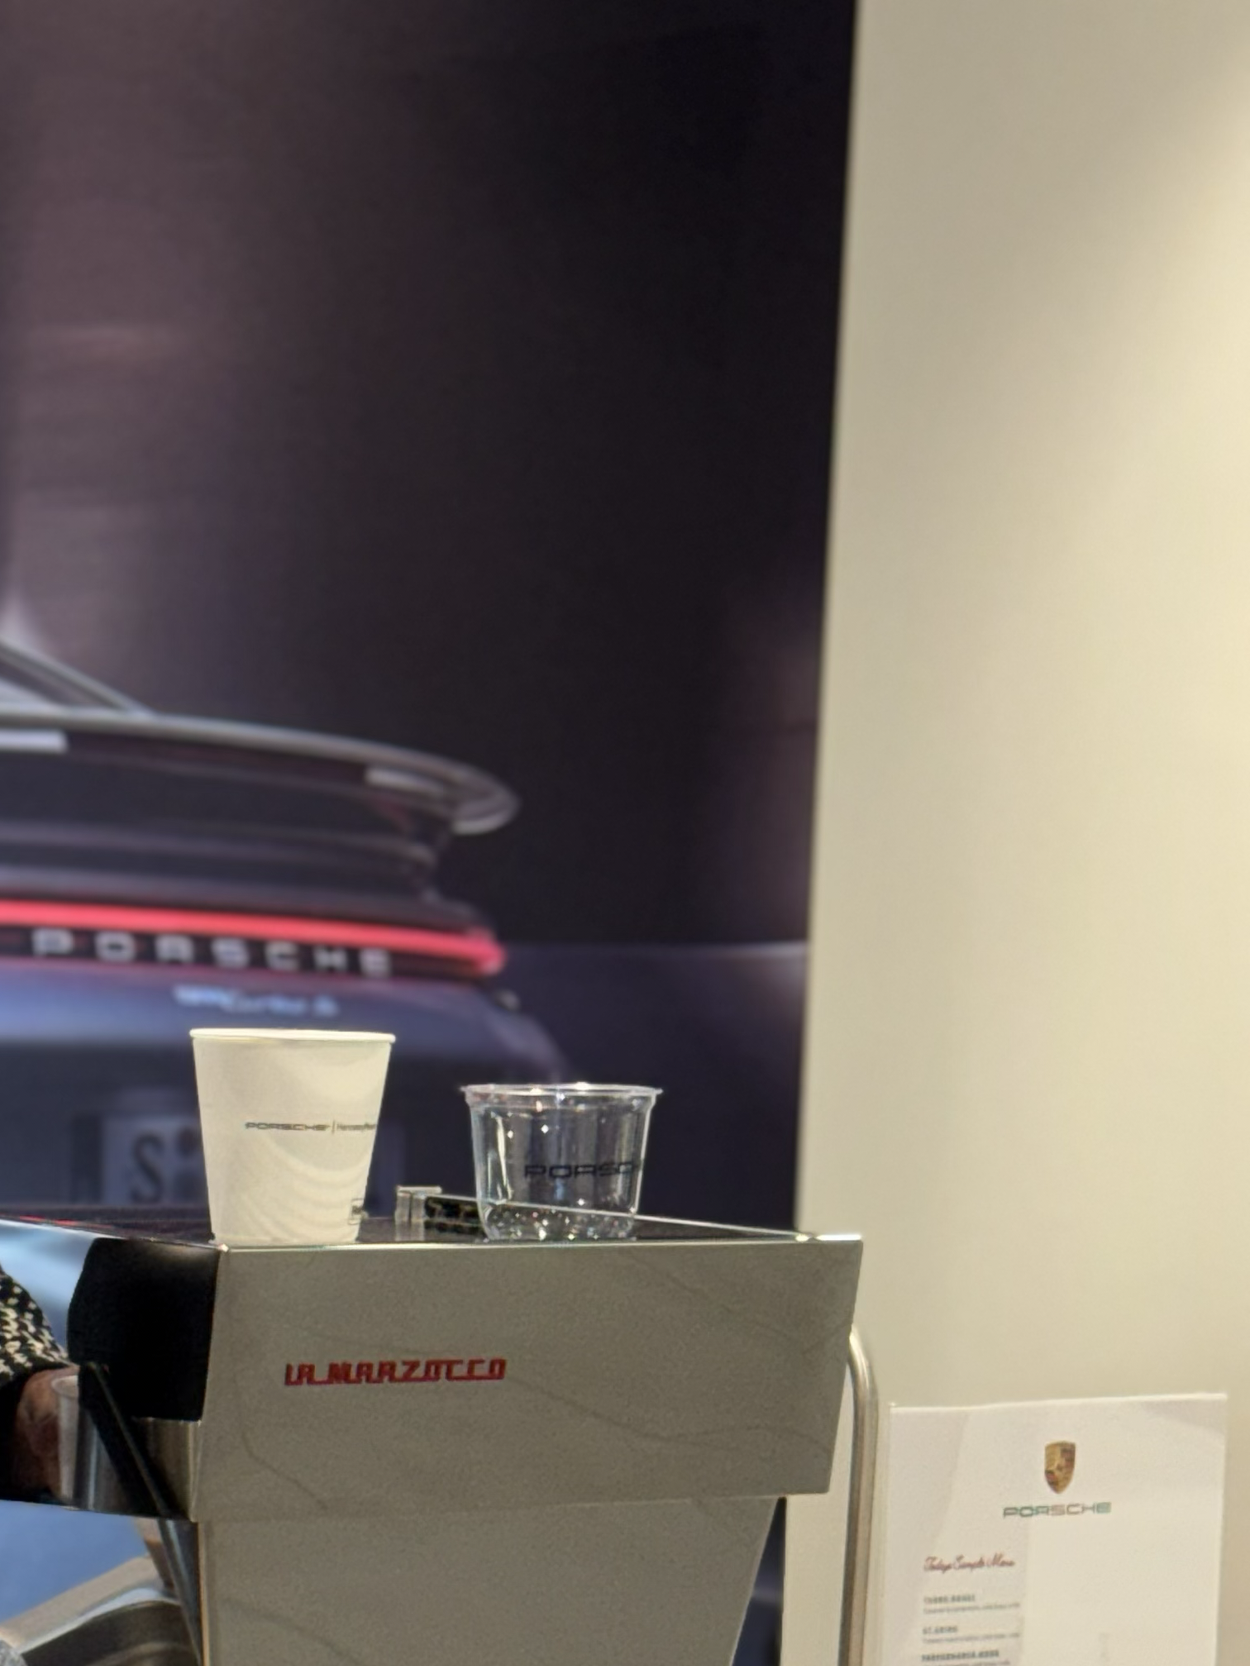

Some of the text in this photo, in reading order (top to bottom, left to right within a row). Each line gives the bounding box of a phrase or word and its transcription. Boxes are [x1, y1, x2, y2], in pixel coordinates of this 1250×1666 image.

[31, 927, 391, 978] PORSCHE
[245, 1121, 330, 1132] PORSCHE
[525, 1161, 638, 1178] PORSC
[326, 1358, 507, 1385] MARZOCCO
[1002, 1502, 1113, 1519] PORSCHE
